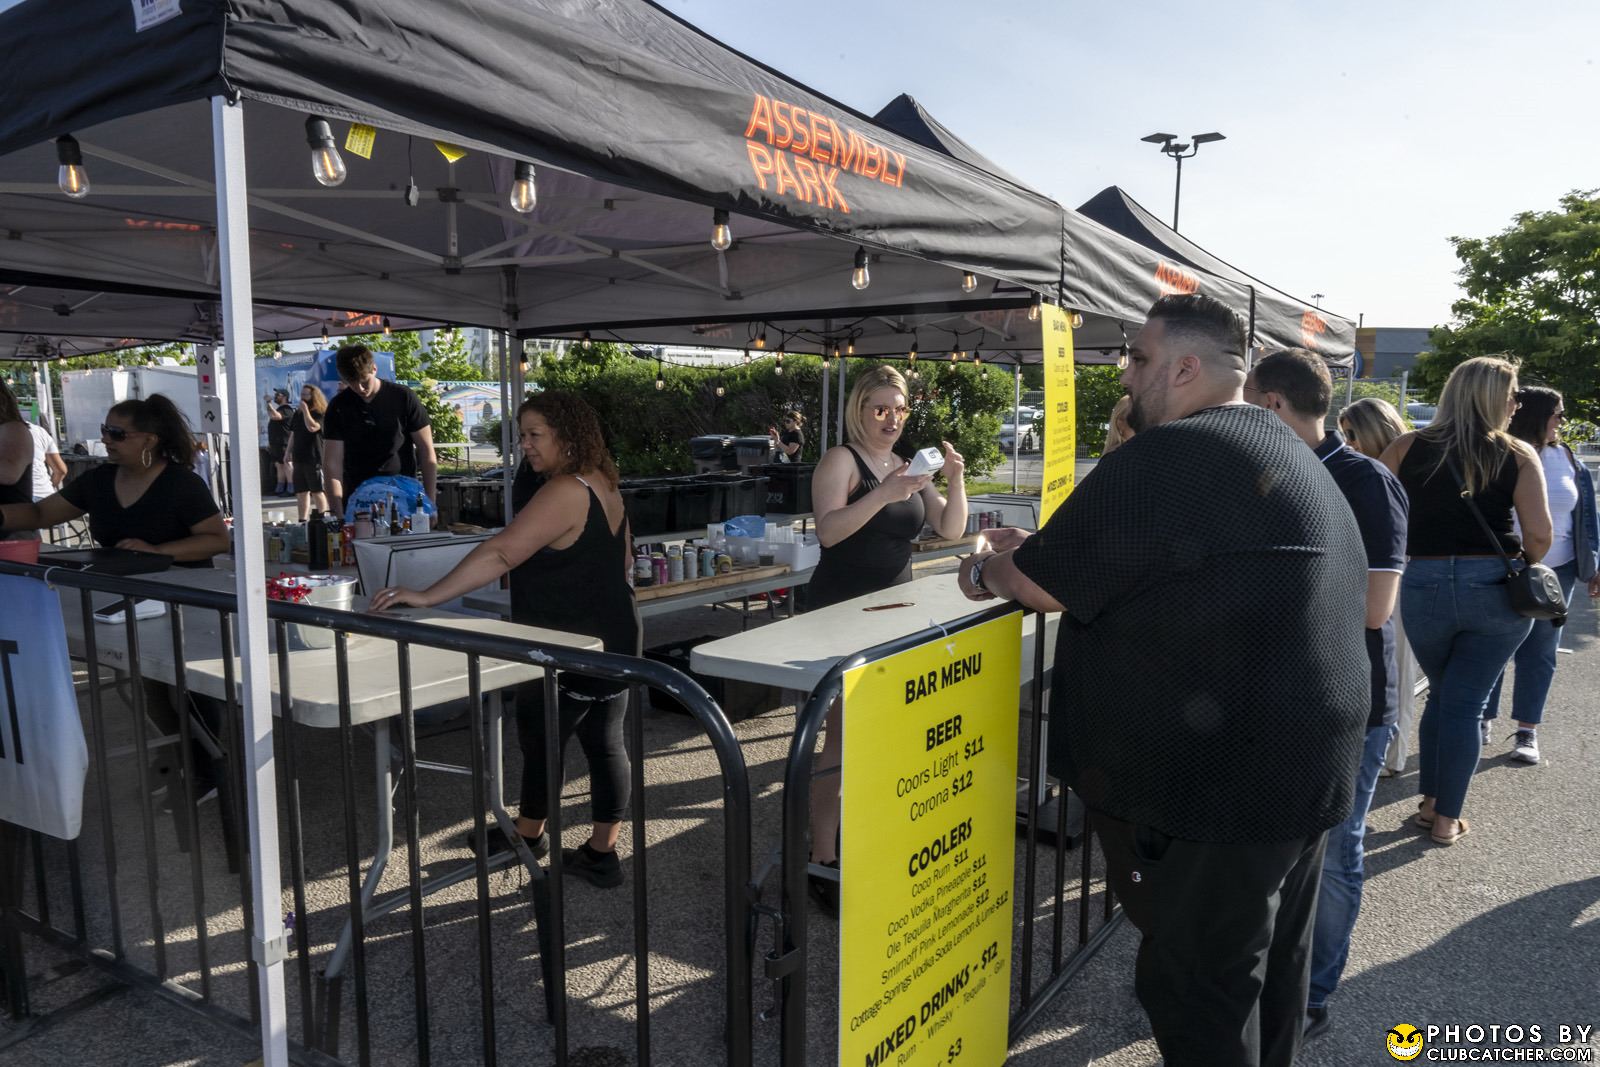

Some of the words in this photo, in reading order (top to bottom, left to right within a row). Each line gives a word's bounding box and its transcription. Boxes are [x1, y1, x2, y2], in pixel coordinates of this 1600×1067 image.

[744, 94, 906, 188] ASSEMBLY
[746, 140, 849, 214] PARK
[905, 671, 937, 705] BAR
[941, 652, 981, 689] MENU
[926, 715, 962, 752] BEER
[897, 768, 930, 797] Coors
[933, 750, 959, 778] Light
[964, 735, 984, 761] $11
[910, 788, 949, 821] Corona
[952, 770, 973, 797] $12
[908, 817, 972, 877] COOLERS
[912, 876, 931, 897] Coco
[934, 863, 950, 883] Rum
[954, 848, 969, 867] $11
[887, 913, 909, 936] Coco
[910, 895, 934, 919] Vodka
[936, 867, 971, 900] Pineapple
[973, 854, 987, 873] $11
[887, 942, 901, 959] Ole
[903, 917, 931, 945] Tequila
[973, 873, 987, 892] $12
[851, 1000, 882, 1031] Cottage
[883, 975, 912, 1005] Springs
[912, 958, 935, 980] Vodka
[936, 941, 953, 962] Soda
[953, 923, 974, 947] Lemon
[975, 913, 981, 924] &
[982, 904, 995, 922] Lime
[995, 891, 1008, 910] $12
[881, 947, 918, 985] Smirnoff
[920, 934, 936, 955] Pink
[938, 904, 974, 939] Lemonade
[976, 889, 989, 908] $12
[865, 1015, 916, 1067] MIXED
[920, 963, 969, 1027] DRINKS
[982, 941, 998, 970] $12
[897, 1044, 916, 1065] Rum
[948, 1037, 962, 1064] $3
